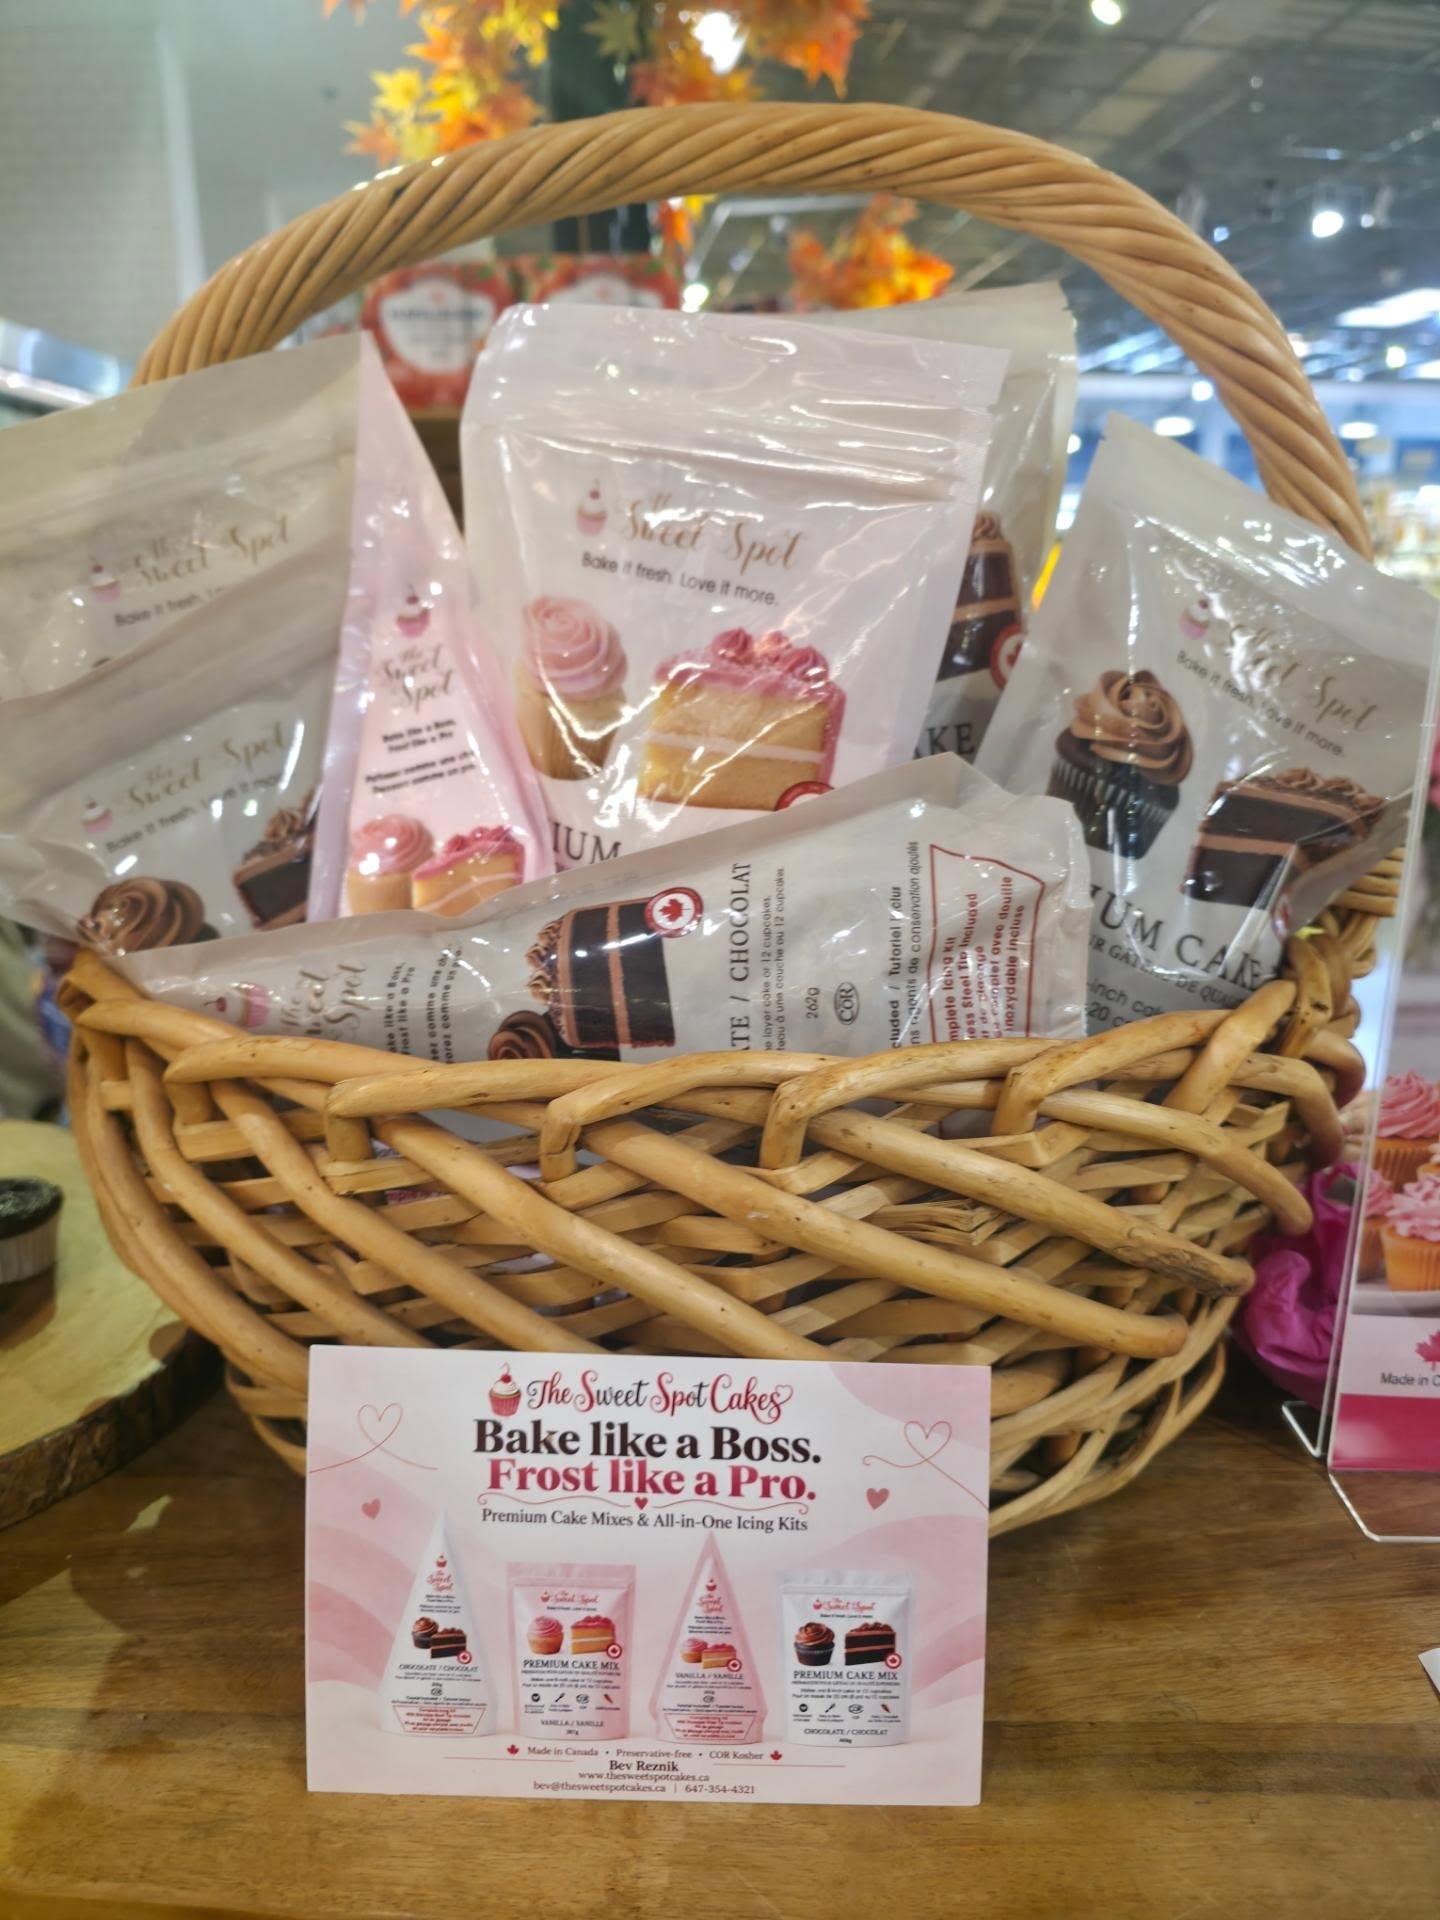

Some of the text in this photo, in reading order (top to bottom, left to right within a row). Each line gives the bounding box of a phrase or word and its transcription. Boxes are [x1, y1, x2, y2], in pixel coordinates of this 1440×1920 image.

[724, 521, 804, 577] Spot
[581, 551, 780, 607] Bake it fresh. Love it more.
[906, 841, 922, 875] ajoutés
[996, 876, 1014, 919] douille
[729, 862, 752, 982] CHOCOLAT
[774, 916, 786, 928] 12
[905, 878, 922, 953] conservation
[958, 893, 979, 947] Included
[1003, 905, 1026, 951] incluse
[776, 932, 786, 945] ou
[888, 927, 902, 976] Tutoriel
[991, 925, 1006, 956] avec
[760, 951, 773, 963] 12
[774, 949, 786, 988] couche
[906, 957, 921, 974] de
[763, 970, 773, 980] or
[761, 990, 773, 1006] cake
[776, 992, 786, 1013] une
[804, 987, 821, 1020] 262g
[961, 976, 975, 1008] Steel
[761, 1014, 774, 1037] layer
[1381, 1373, 1415, 1386] Made
[1418, 1373, 1430, 1387] in
[526, 1370, 795, 1425] The Sweet Spot Cakes
[473, 1419, 822, 1465] Bake like a Boss.
[487, 1458, 817, 1501] Frost like a Pro.
[482, 1508, 808, 1534] Premium Cake Mixes & All-in-One Icing Kits
[523, 1659, 620, 1671] PREMIUM CAKE MIX
[793, 1670, 898, 1681] PREMIUM CAKE MIX
[803, 1728, 844, 1736] CHOCOLATE
[851, 1729, 888, 1737] CHOCOLAT
[527, 1746, 764, 1760] Made in Canada Preservative-free COR Kosher
[609, 1760, 679, 1772] Bev Reznik
[533, 1780, 756, 1794] bev@thesweetspotcakes.ca 647-354-4321
[578, 1771, 710, 1783] www.thesweetspotcakes.ca
